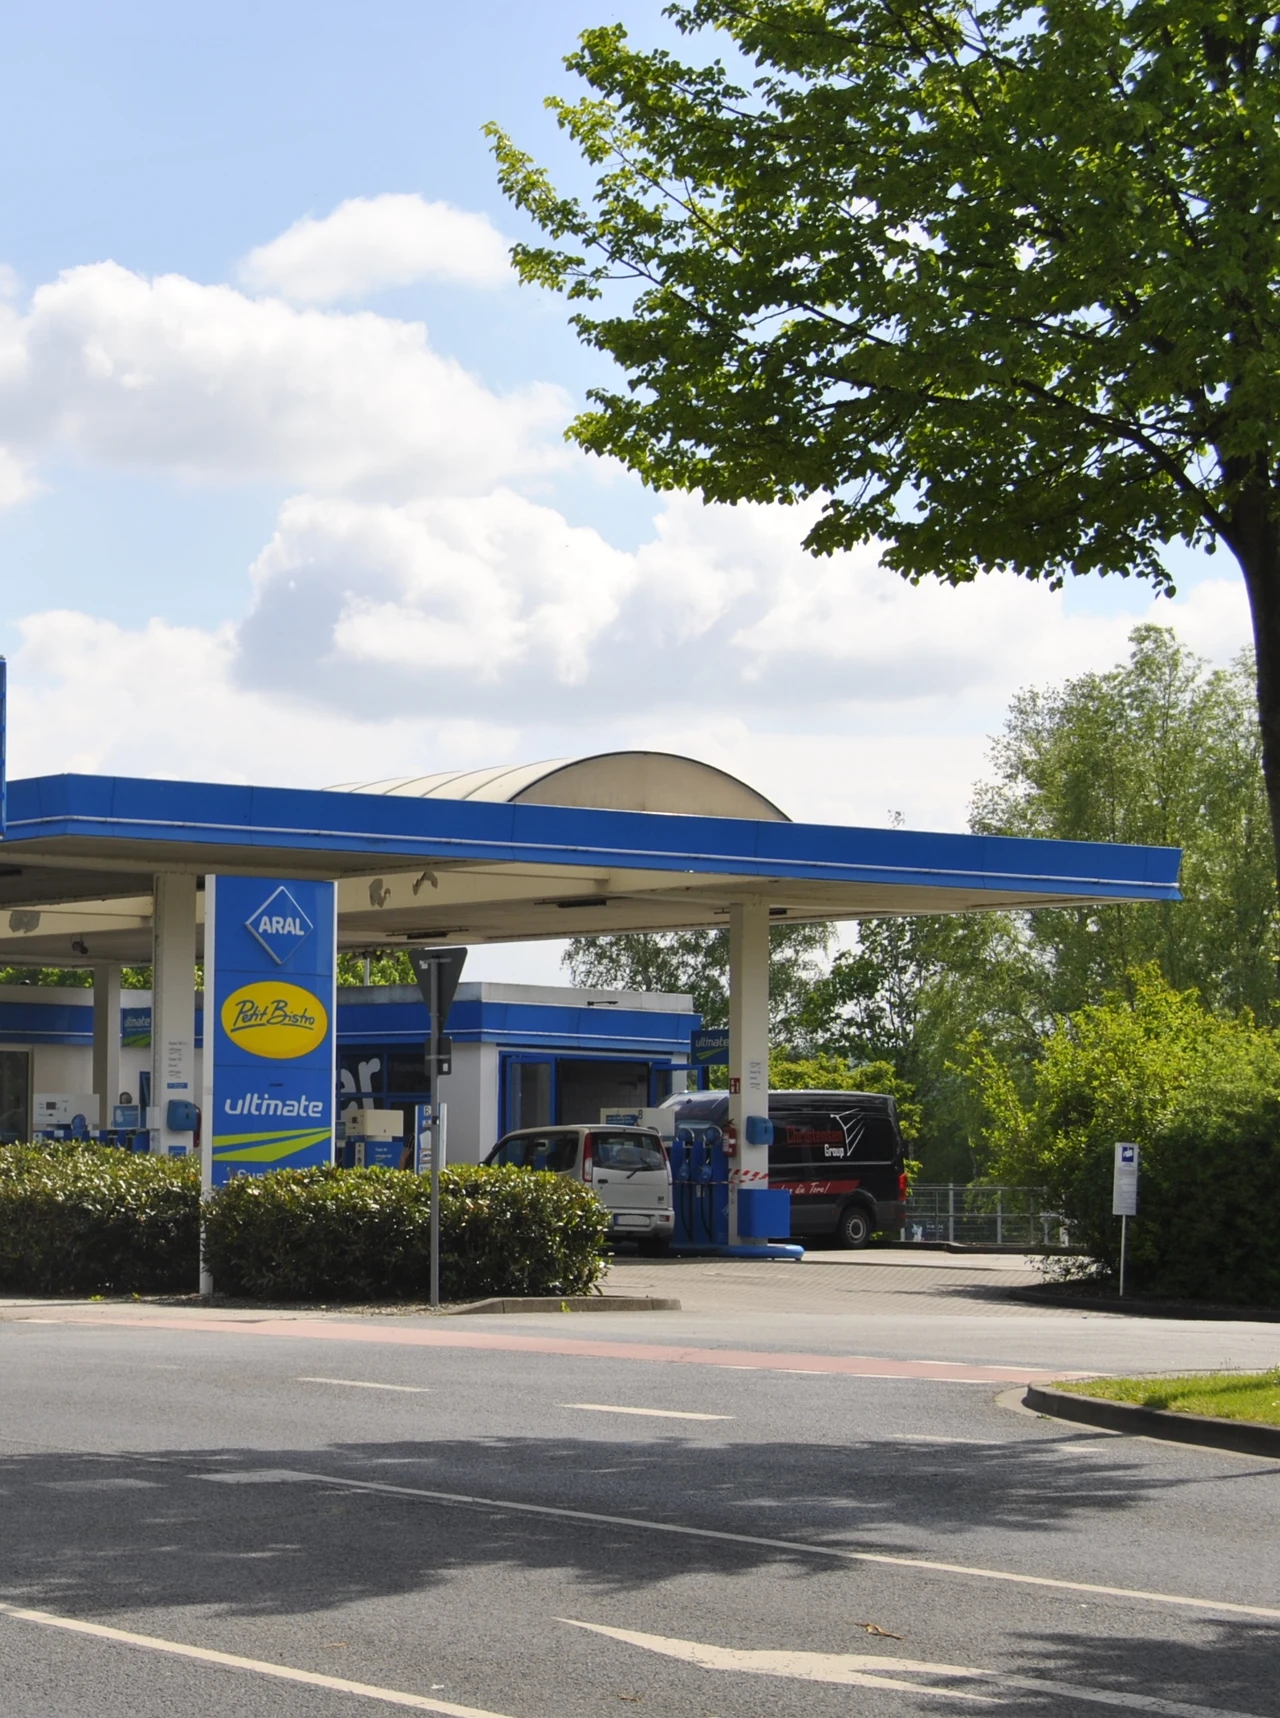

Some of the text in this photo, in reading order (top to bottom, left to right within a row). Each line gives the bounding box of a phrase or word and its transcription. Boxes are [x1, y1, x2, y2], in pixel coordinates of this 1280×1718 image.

[258, 915, 305, 935] ARAL
[233, 1000, 315, 1027] Petit Bistro
[695, 1036, 729, 1047] ultimate
[224, 1093, 323, 1117] ultimate
[786, 1125, 843, 1143] Christensen
[824, 1144, 845, 1159] Group
